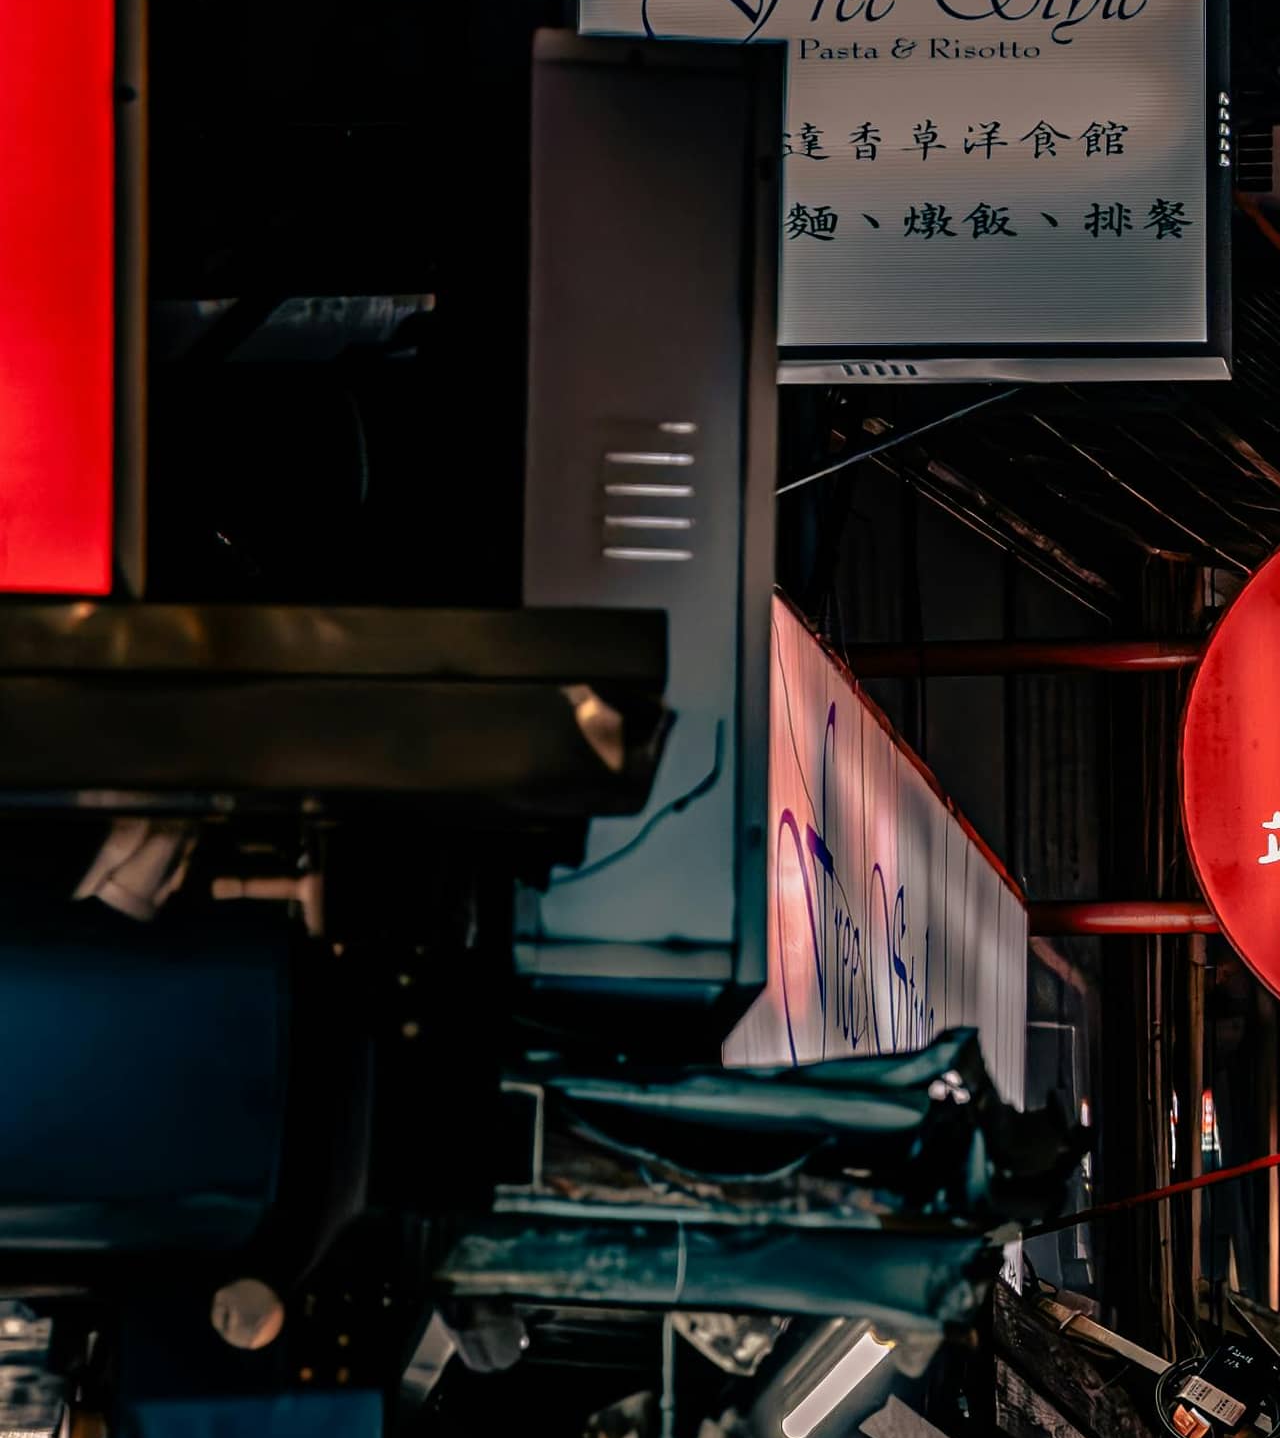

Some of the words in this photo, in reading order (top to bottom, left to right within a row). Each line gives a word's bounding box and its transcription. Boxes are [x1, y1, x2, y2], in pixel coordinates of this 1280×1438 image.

[799, 37, 879, 60] Pasta
[891, 37, 917, 60] &
[928, 37, 1041, 60] Risotto
